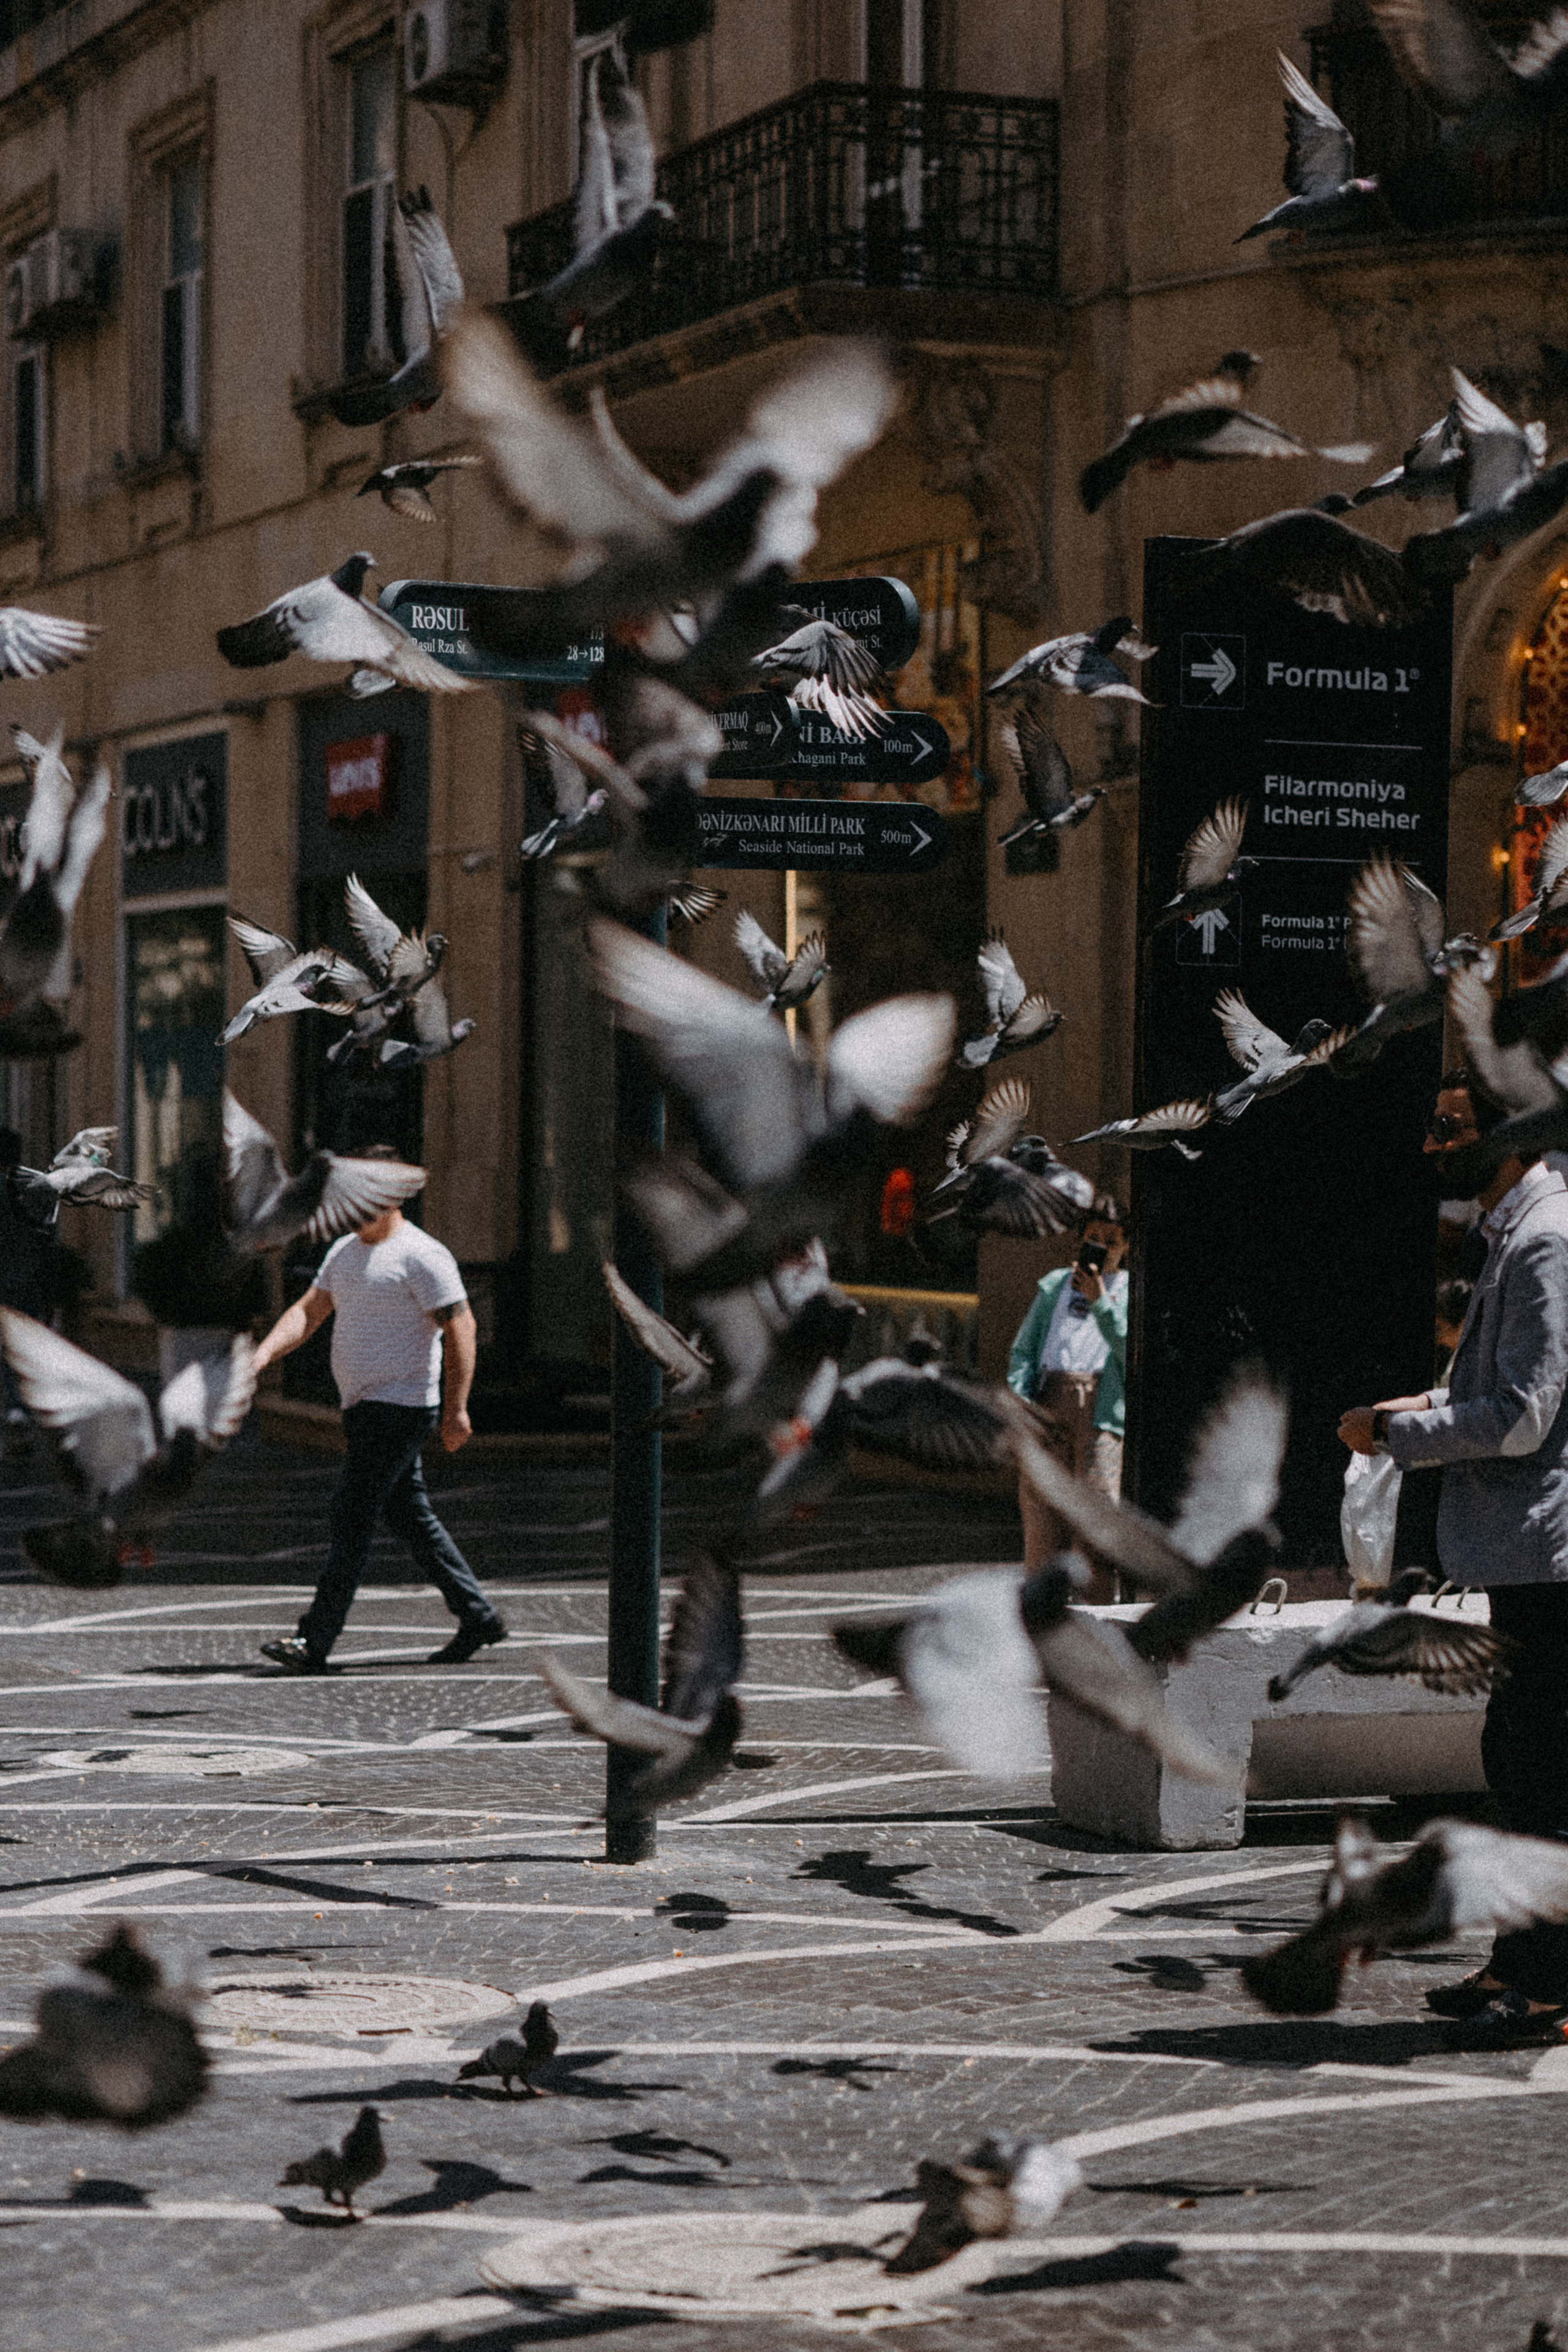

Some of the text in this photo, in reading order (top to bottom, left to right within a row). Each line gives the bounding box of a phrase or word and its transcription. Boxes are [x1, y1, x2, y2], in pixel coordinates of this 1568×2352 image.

[412, 605, 469, 631] RƏSUL
[832, 605, 882, 630] KÜÇƏSİ
[438, 639, 454, 654] Rza
[457, 640, 468, 654] St.
[1267, 662, 1388, 692] Formula
[883, 739, 913, 753] 100m
[840, 752, 866, 765] Park
[1264, 774, 1406, 803] Filarmoniya
[788, 812, 827, 834] MİLLİ
[830, 816, 865, 835] PARK
[1264, 805, 1420, 830] Icheri Sheher
[880, 829, 913, 845] 500m
[738, 839, 865, 856] Seaside National Park
[1262, 914, 1325, 929] Formula
[1262, 935, 1325, 950] Formula
